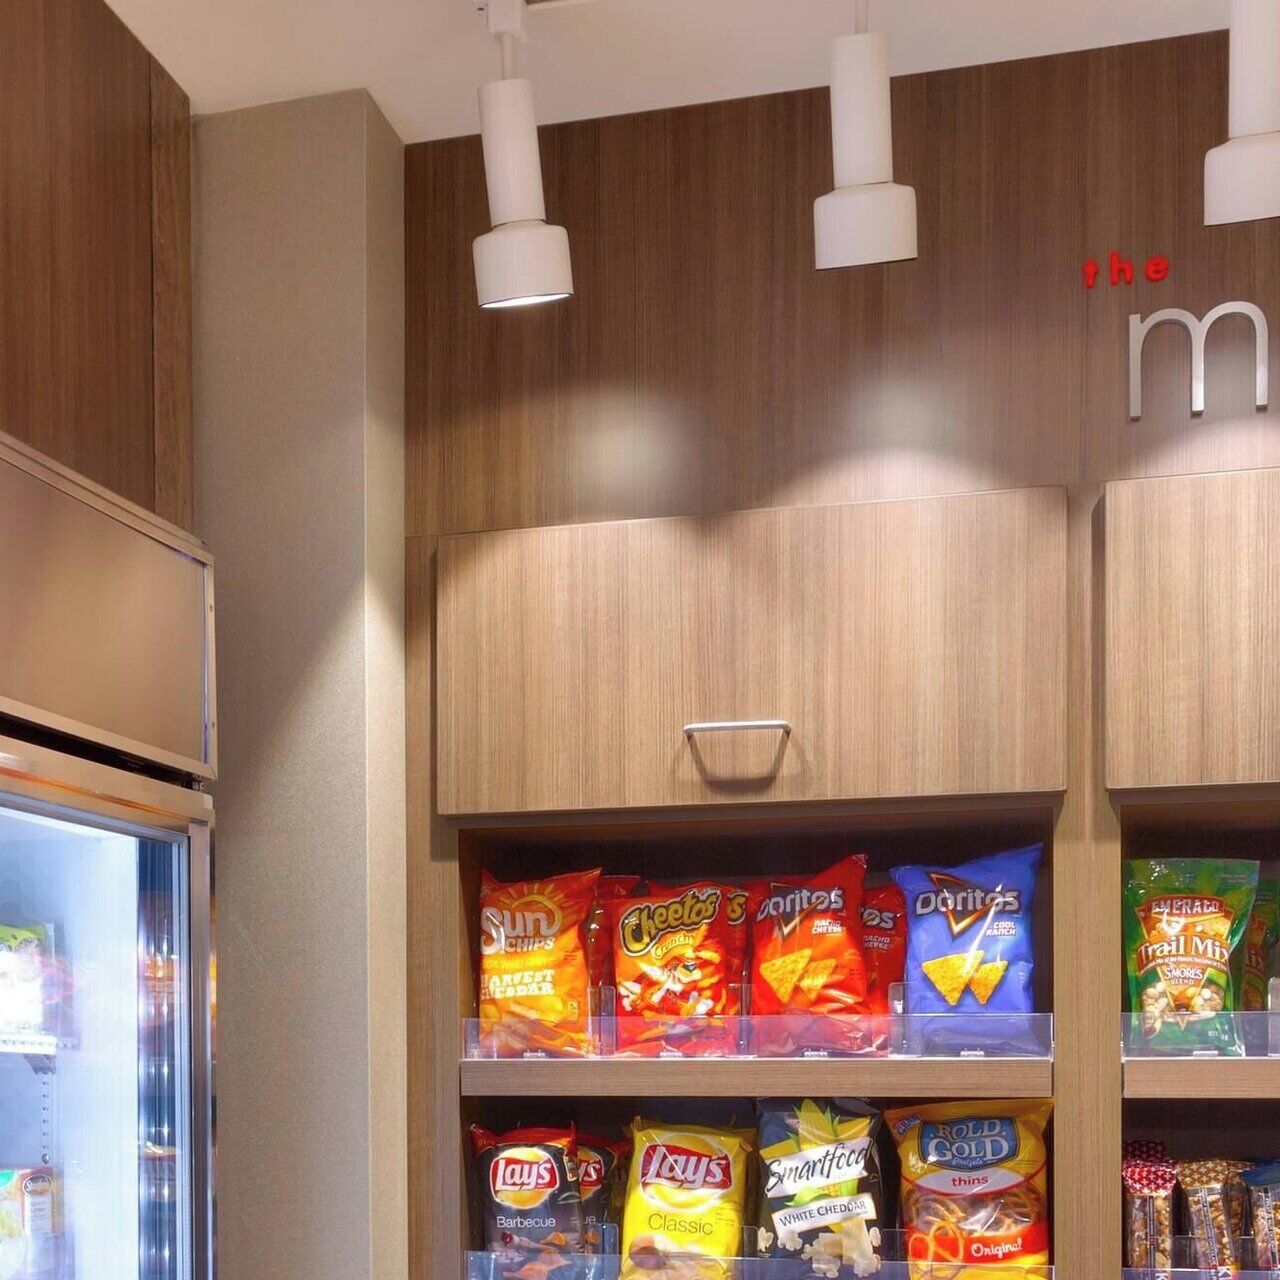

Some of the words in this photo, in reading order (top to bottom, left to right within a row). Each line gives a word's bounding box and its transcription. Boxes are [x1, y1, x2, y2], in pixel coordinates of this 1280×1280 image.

[1082, 252, 1169, 288] the
[756, 886, 844, 922] Doritos
[916, 888, 1019, 914] Doritos
[1152, 900, 1220, 914] EMERALD
[481, 907, 562, 954] Sun
[620, 889, 721, 956] Cheetos
[986, 928, 1016, 936] RANCH
[505, 937, 555, 952] CHIPS
[1139, 936, 1189, 966] Trail
[1190, 936, 1230, 966] Mix
[938, 1119, 1002, 1139] ROLD
[928, 1135, 1010, 1161] GOLD
[495, 1157, 552, 1191] Lay's
[644, 1145, 727, 1191] Lay's
[765, 1139, 873, 1192] Smartfood
[952, 1174, 989, 1187] thins
[497, 1216, 556, 1229] Barbecue
[648, 1213, 713, 1236] Classic
[779, 1209, 815, 1228] WHITE
[817, 1200, 867, 1217] CHEDDAR
[971, 1238, 1023, 1258] Original
